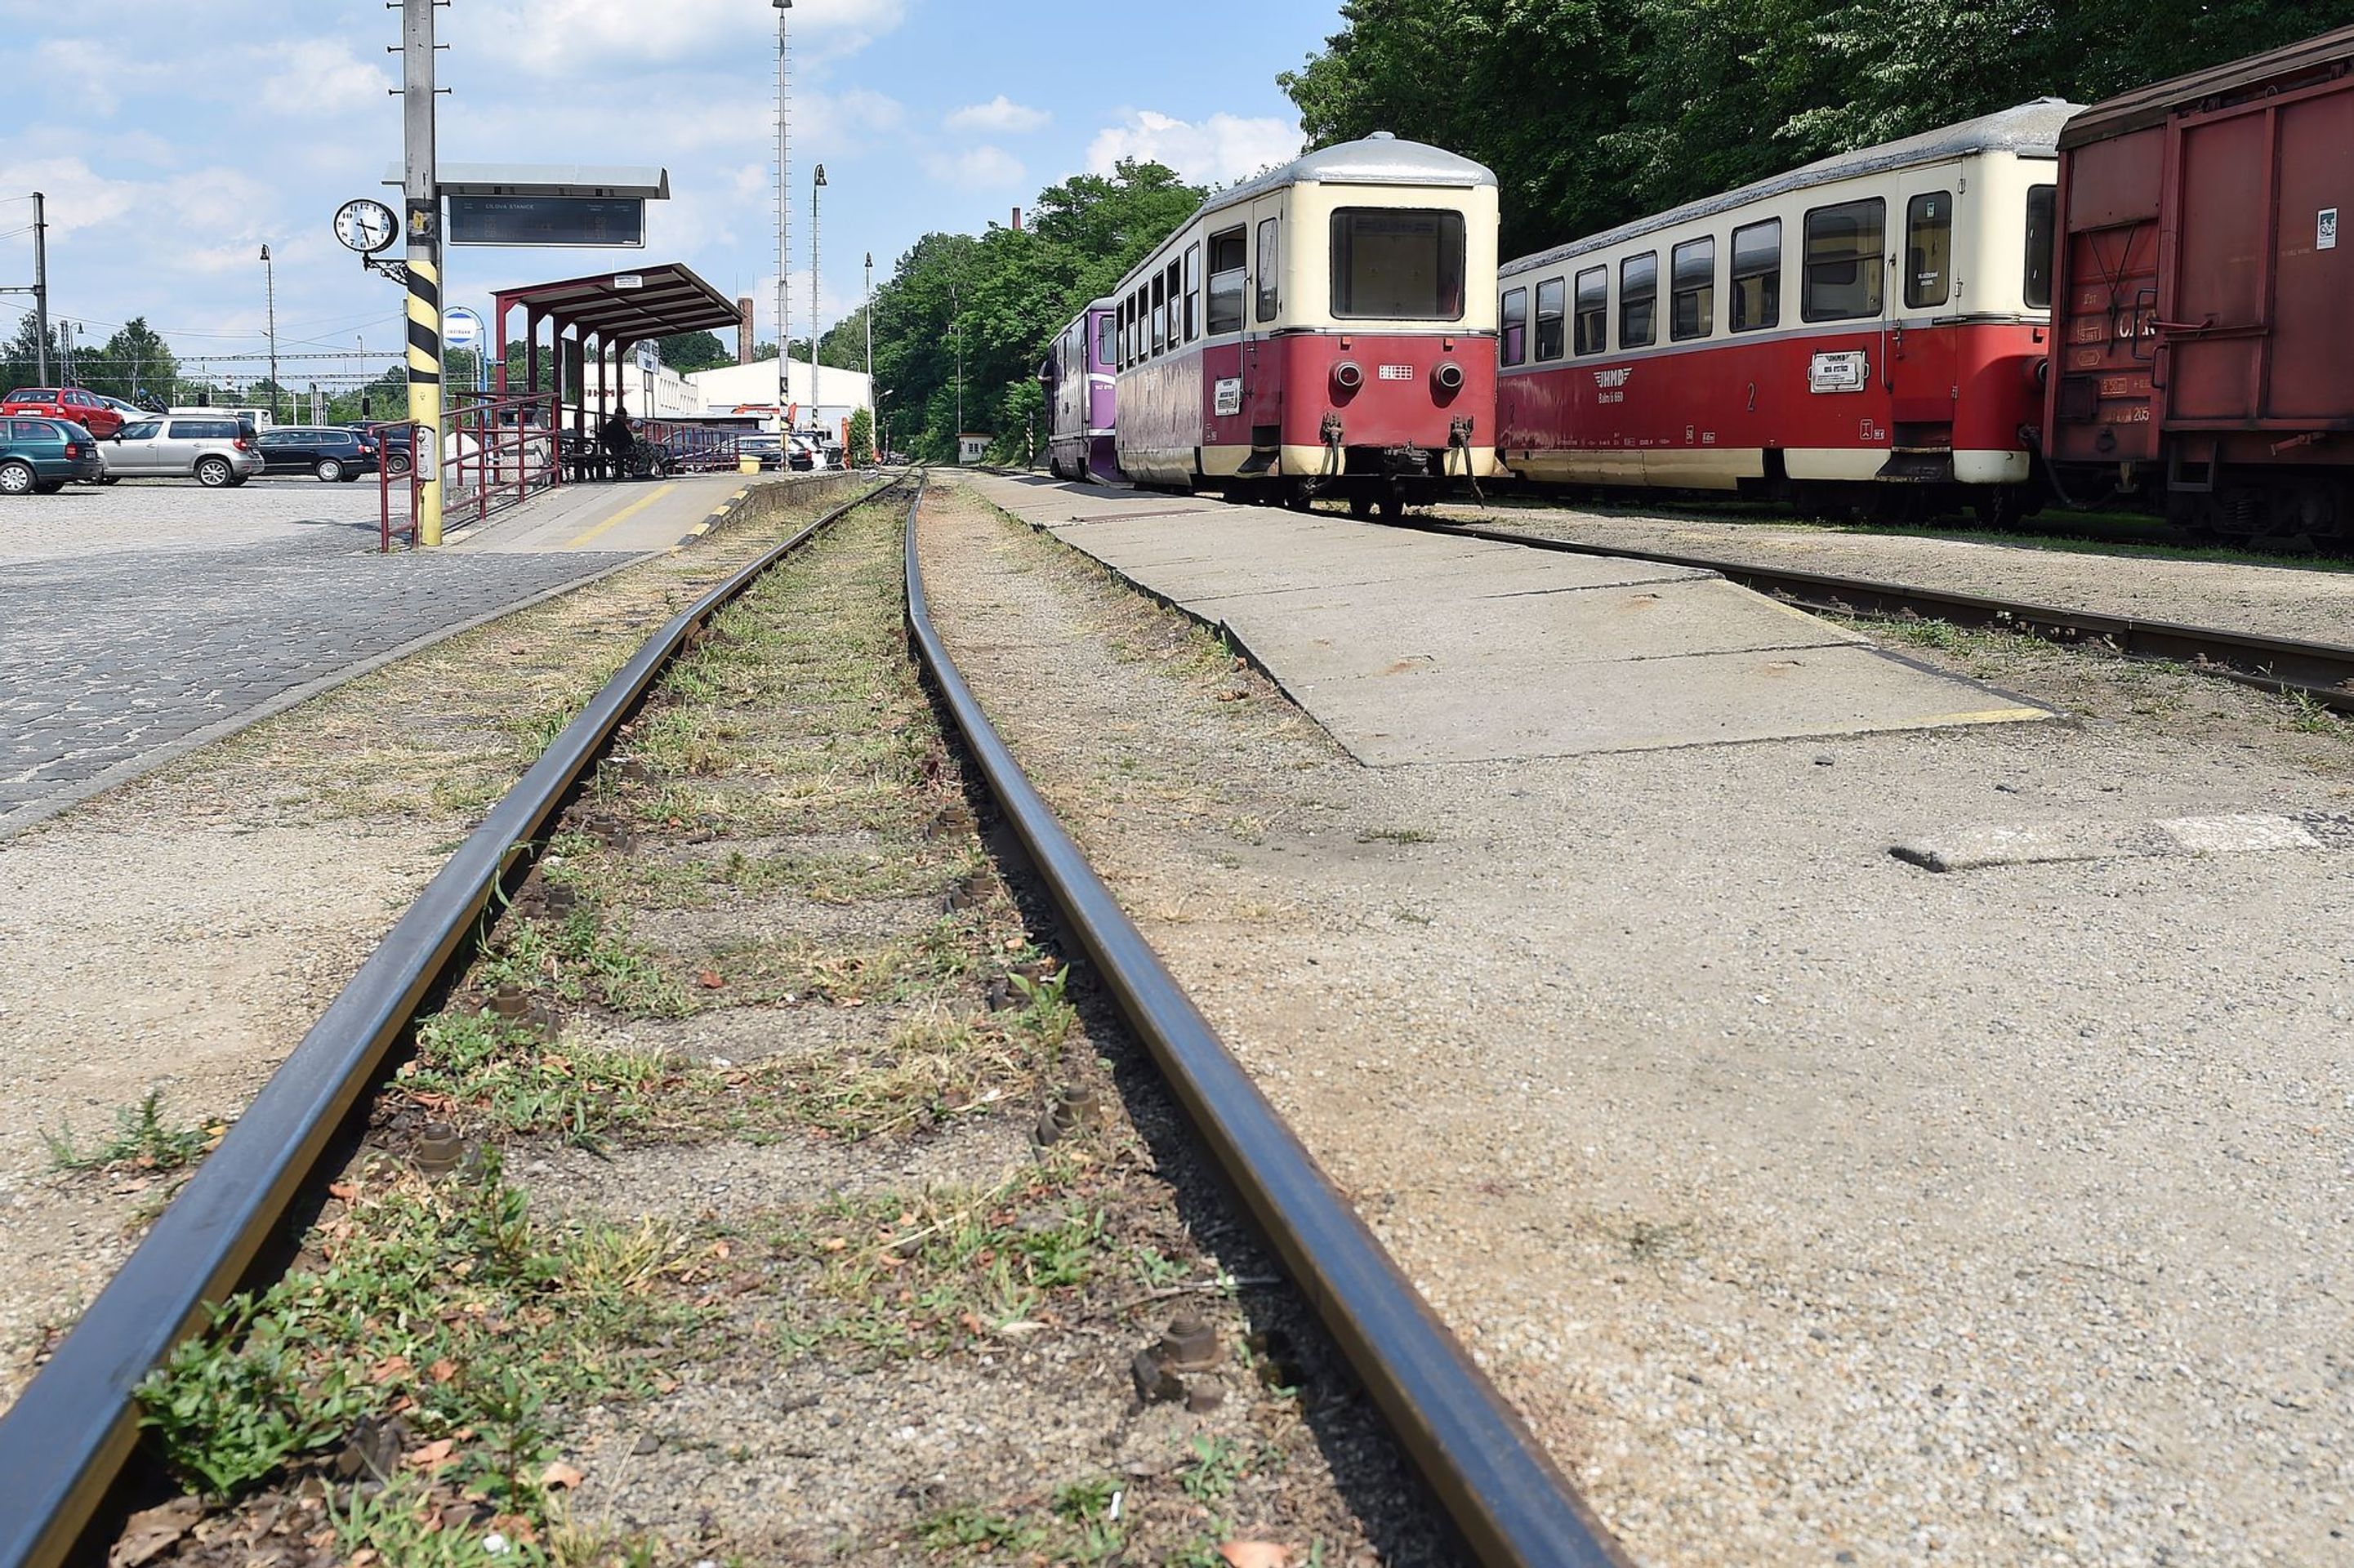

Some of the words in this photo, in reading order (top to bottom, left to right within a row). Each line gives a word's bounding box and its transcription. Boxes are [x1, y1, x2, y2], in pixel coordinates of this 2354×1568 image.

[380, 212, 386, 220] 2
[1598, 368, 1625, 388] JHMD
[1747, 381, 1755, 412] 2
[2133, 407, 2150, 421] 205
